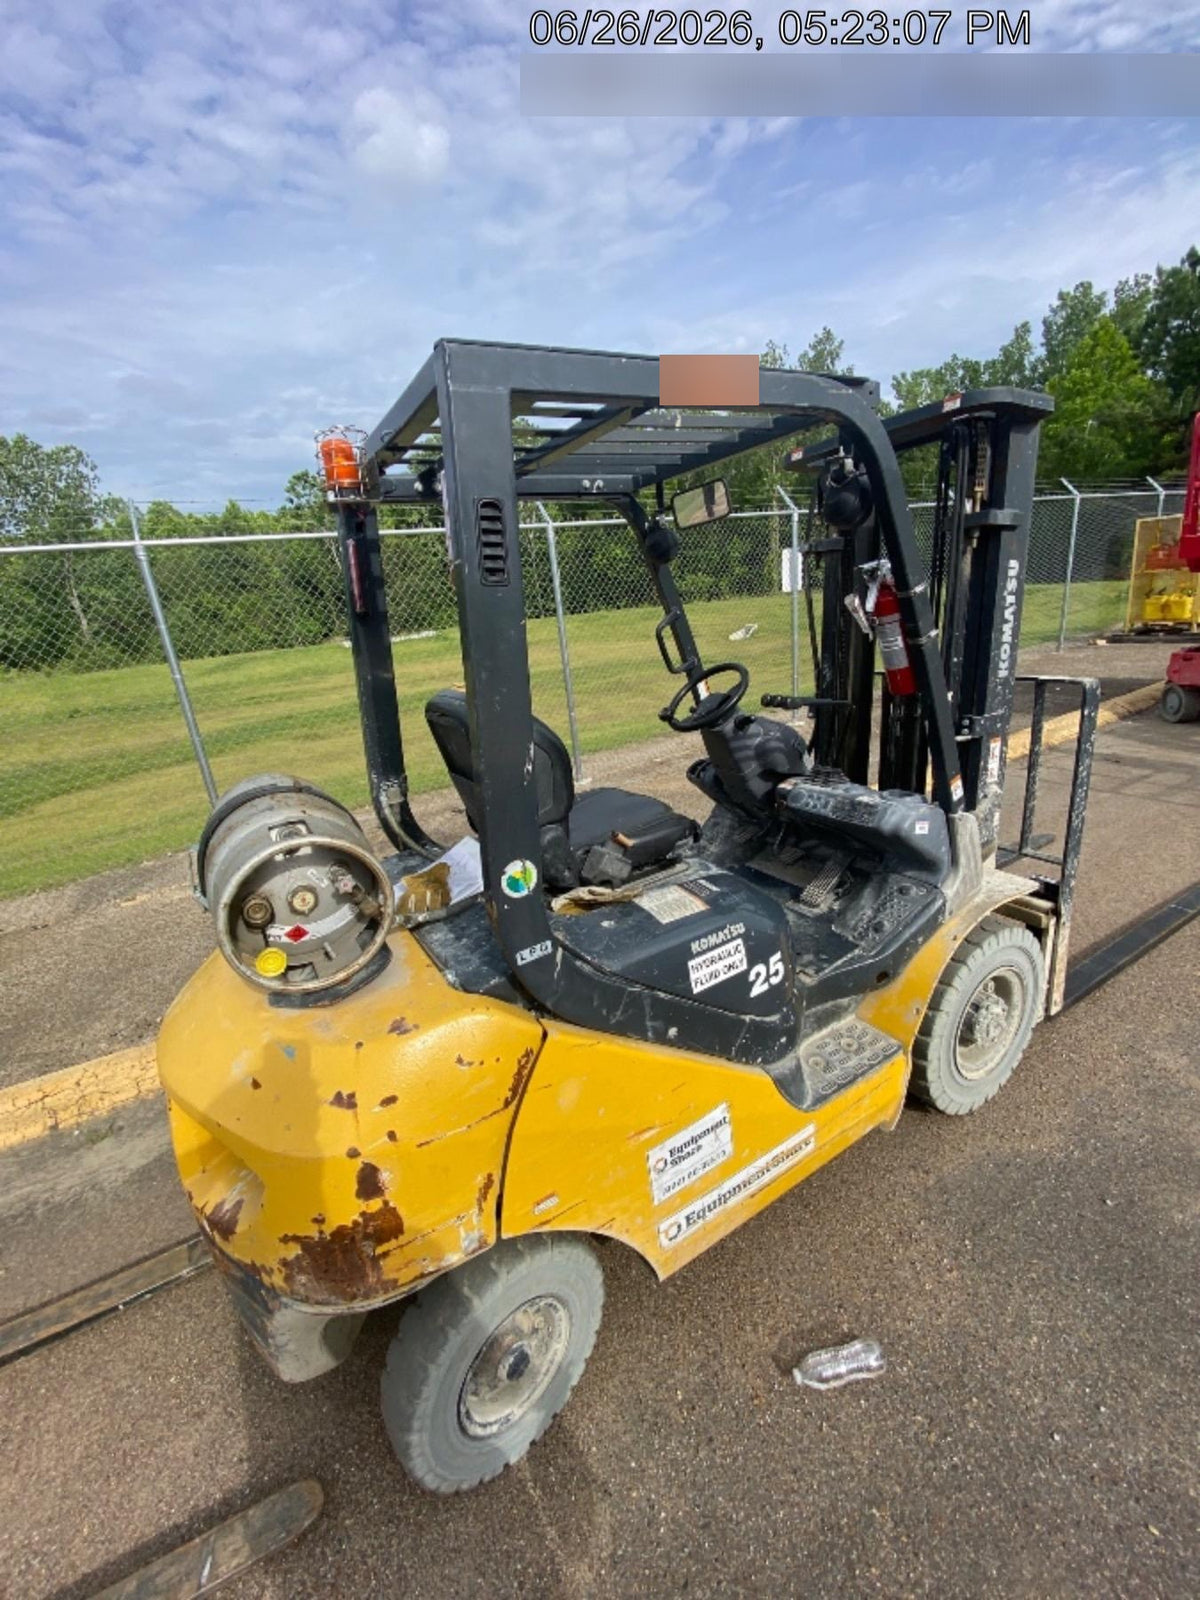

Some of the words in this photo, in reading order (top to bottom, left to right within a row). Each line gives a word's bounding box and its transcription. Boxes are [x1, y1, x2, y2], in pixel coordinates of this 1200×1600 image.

[997, 559, 1020, 678] KOMATSU
[690, 922, 746, 954] KOMATSU
[691, 943, 743, 976] HYDRAULIC
[693, 969, 721, 989] FLUID
[722, 957, 746, 976] ONLY
[748, 951, 785, 998] 25
[668, 1115, 729, 1159] Equipment
[669, 1144, 704, 1168] Share
